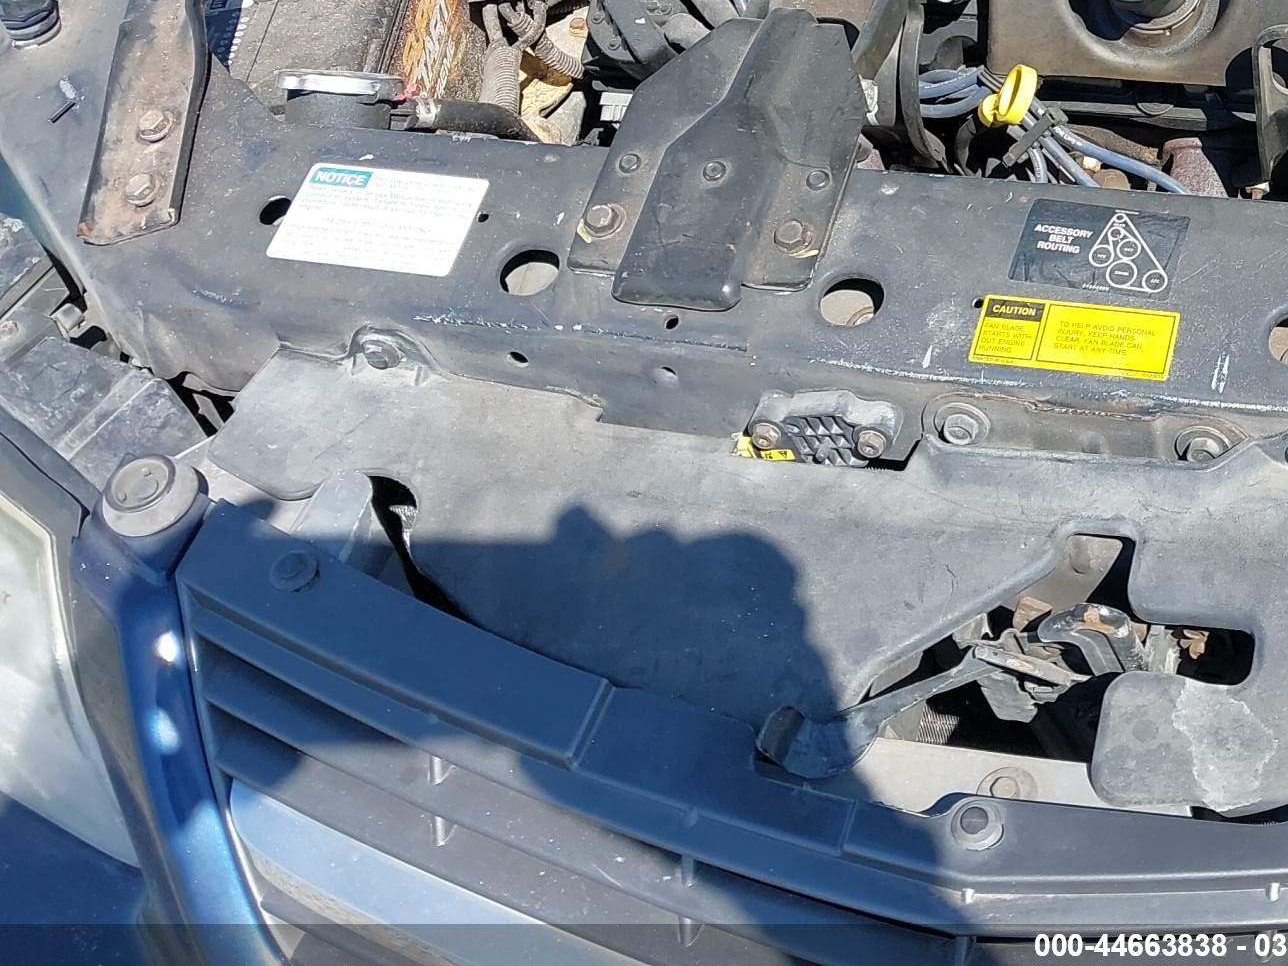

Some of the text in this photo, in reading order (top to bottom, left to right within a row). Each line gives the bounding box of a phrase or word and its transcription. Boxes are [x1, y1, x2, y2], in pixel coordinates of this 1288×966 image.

[315, 170, 368, 186] NOTICE
[1034, 224, 1094, 238] ACCESSORY
[1049, 235, 1074, 244] BELT
[1037, 241, 1080, 254] ROUTING
[992, 304, 1036, 316] CAUTION
[1001, 324, 1024, 332] BLADE
[1072, 321, 1091, 329] HELP
[1092, 323, 1115, 332] AVOID
[1117, 325, 1157, 336] PERSONAL
[982, 330, 1011, 338] STARTS
[1088, 330, 1108, 338] KEEP
[1109, 333, 1135, 341] HANDS
[997, 339, 1025, 347] ENGINE
[1054, 343, 1077, 351] START
[1100, 339, 1125, 347] BLADE
